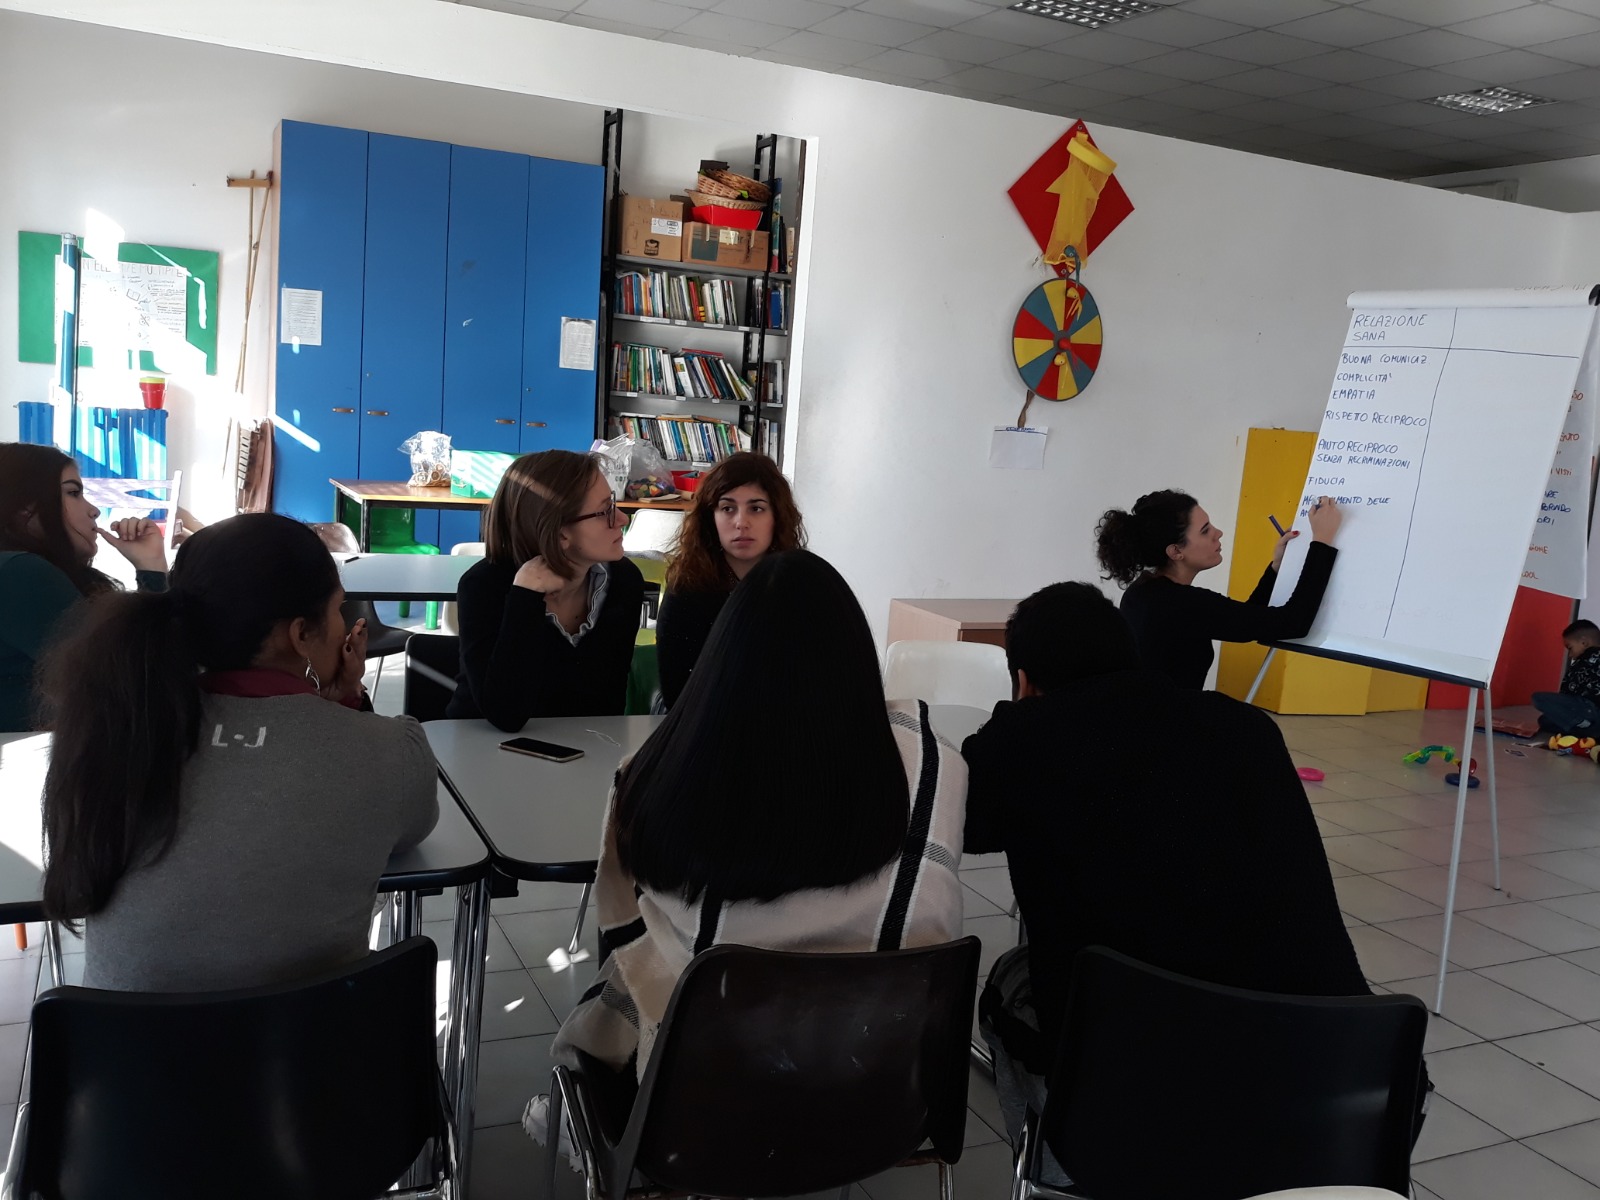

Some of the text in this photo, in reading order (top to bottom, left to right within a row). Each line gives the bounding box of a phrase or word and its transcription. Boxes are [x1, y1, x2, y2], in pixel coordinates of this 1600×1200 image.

[1353, 314, 1428, 329] RELAZIONE
[1352, 330, 1386, 341] SANA
[1342, 352, 1372, 365] BUONA
[1332, 388, 1376, 400] EMPATIA
[1371, 411, 1427, 427] RECIPROCO
[1346, 440, 1399, 454] RECIPROCO
[1317, 453, 1342, 464] SENZA
[1308, 476, 1346, 486] FIDUCIA
[1366, 497, 1391, 506] DELLE
